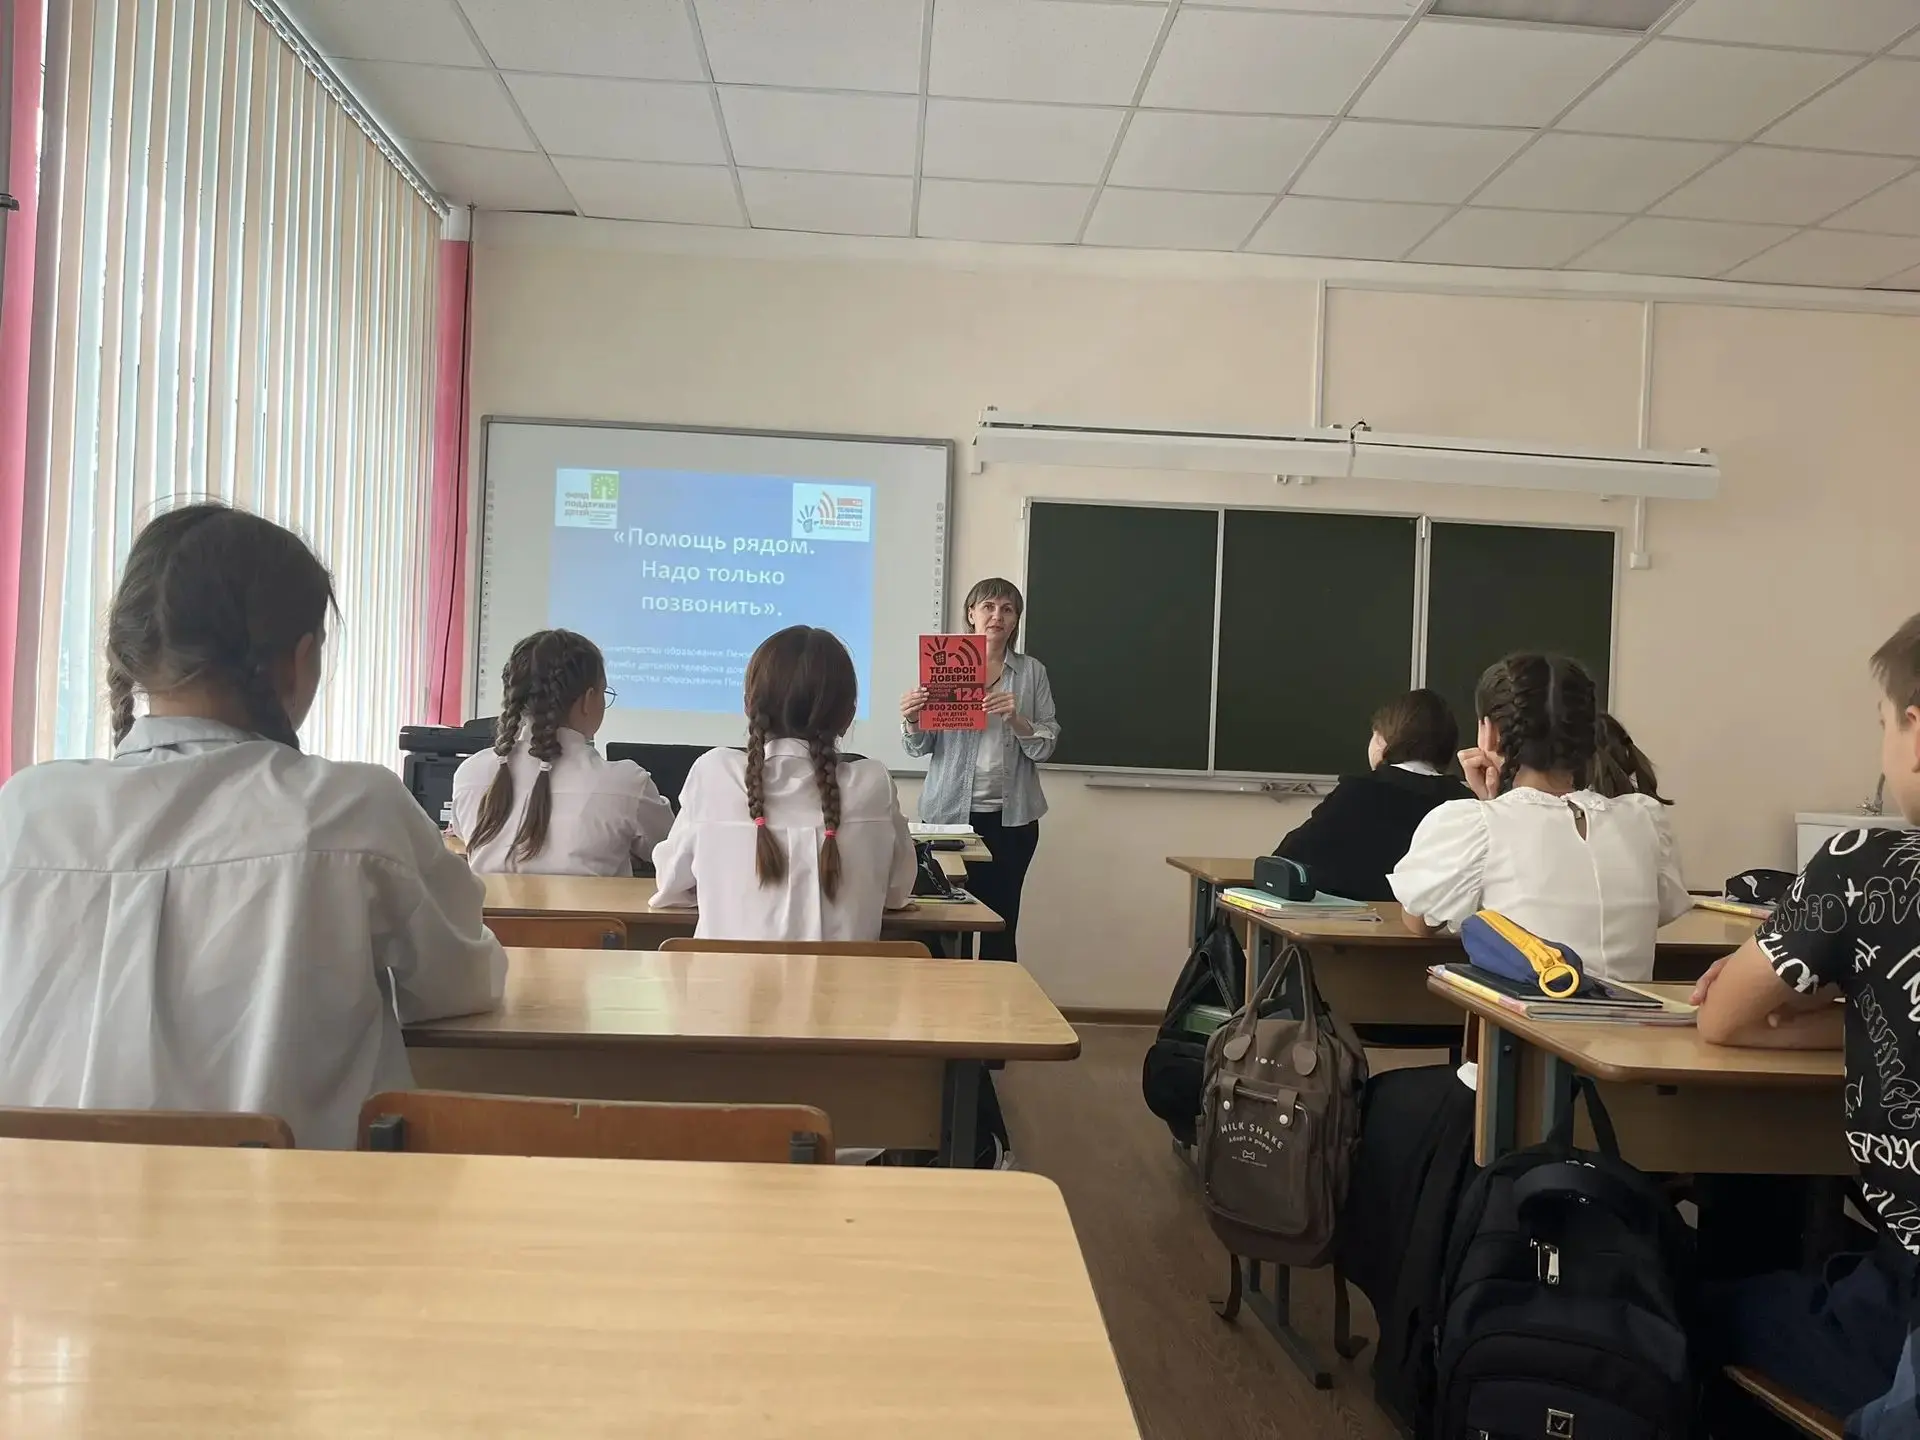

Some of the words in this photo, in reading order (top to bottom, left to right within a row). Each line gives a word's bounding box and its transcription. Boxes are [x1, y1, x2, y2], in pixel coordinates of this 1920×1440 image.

[614, 526, 727, 553] «Помощь
[734, 537, 815, 556] рядом.
[642, 560, 700, 583] Надо
[707, 567, 785, 585] только
[642, 596, 783, 616] позвонить».
[930, 675, 976, 683] ДОВЕРИЯ
[954, 687, 984, 701] 124
[1221, 1122, 1244, 1134] MILK
[1249, 1123, 1284, 1150] SHAKE
